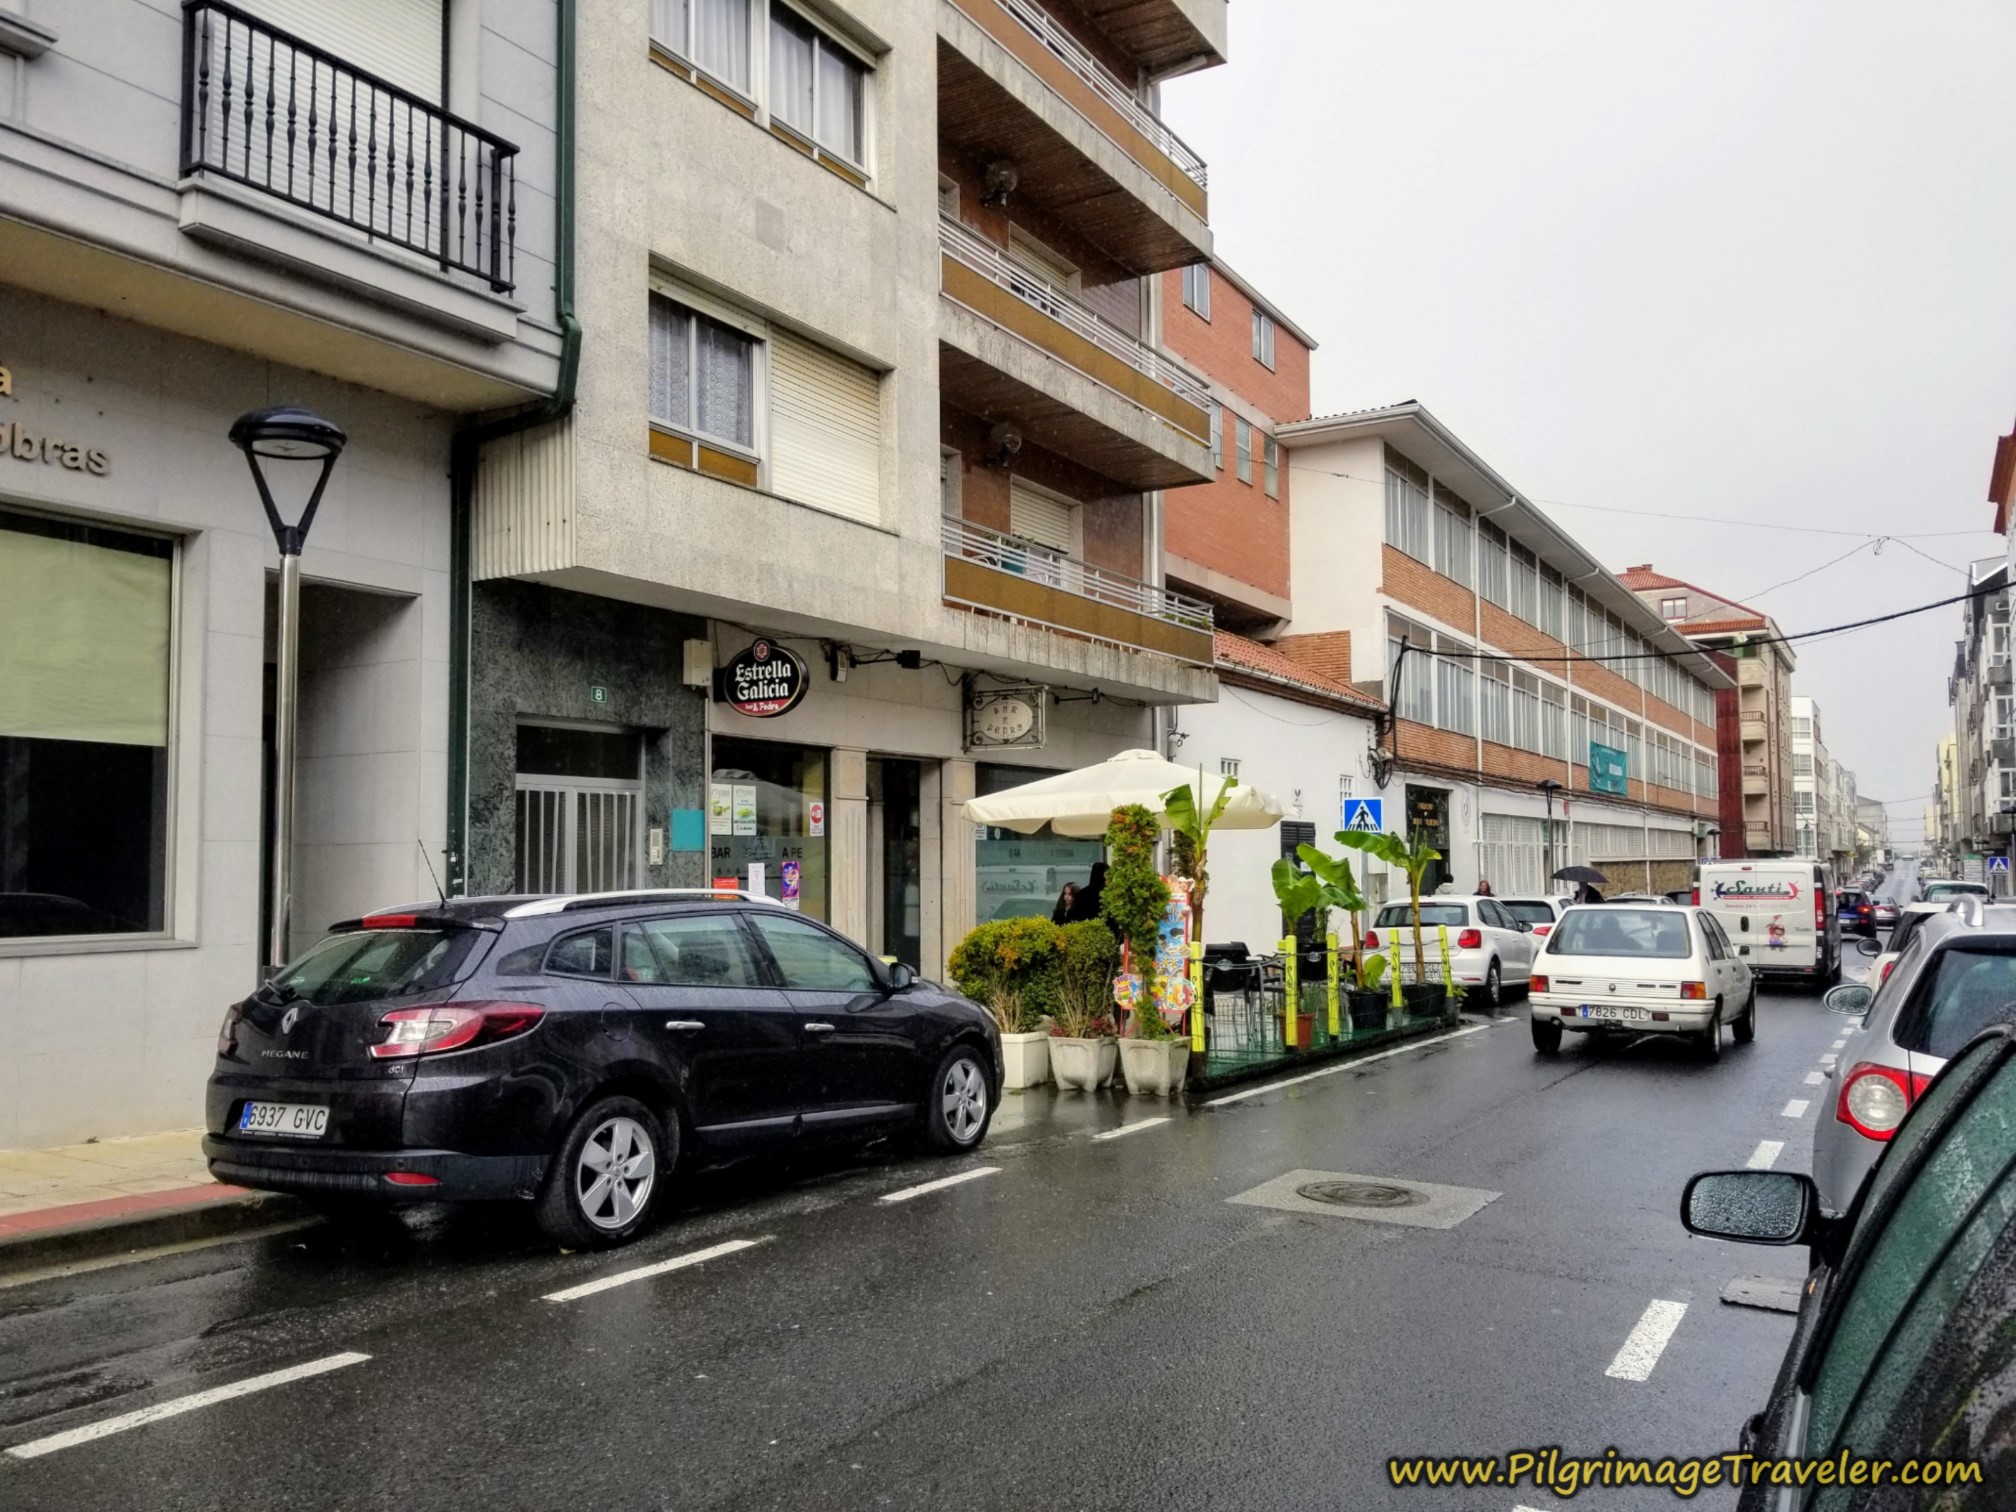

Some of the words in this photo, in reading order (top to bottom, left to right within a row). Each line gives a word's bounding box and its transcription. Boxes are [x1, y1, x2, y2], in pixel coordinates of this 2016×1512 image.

[734, 659, 792, 682] Estrella
[595, 689, 603, 701] 8
[737, 679, 790, 701] Galicia
[759, 701, 779, 711] Pedra
[993, 705, 1018, 715] BAR
[986, 723, 1024, 735] PEDRA
[711, 847, 731, 859] BAR
[1726, 879, 1782, 894] Santi
[1588, 1006, 1617, 1018] 7826
[1622, 1008, 1645, 1020] CDL
[261, 1049, 309, 1059] MEGANE
[248, 1105, 287, 1128] 6937
[293, 1107, 326, 1130] GVC
